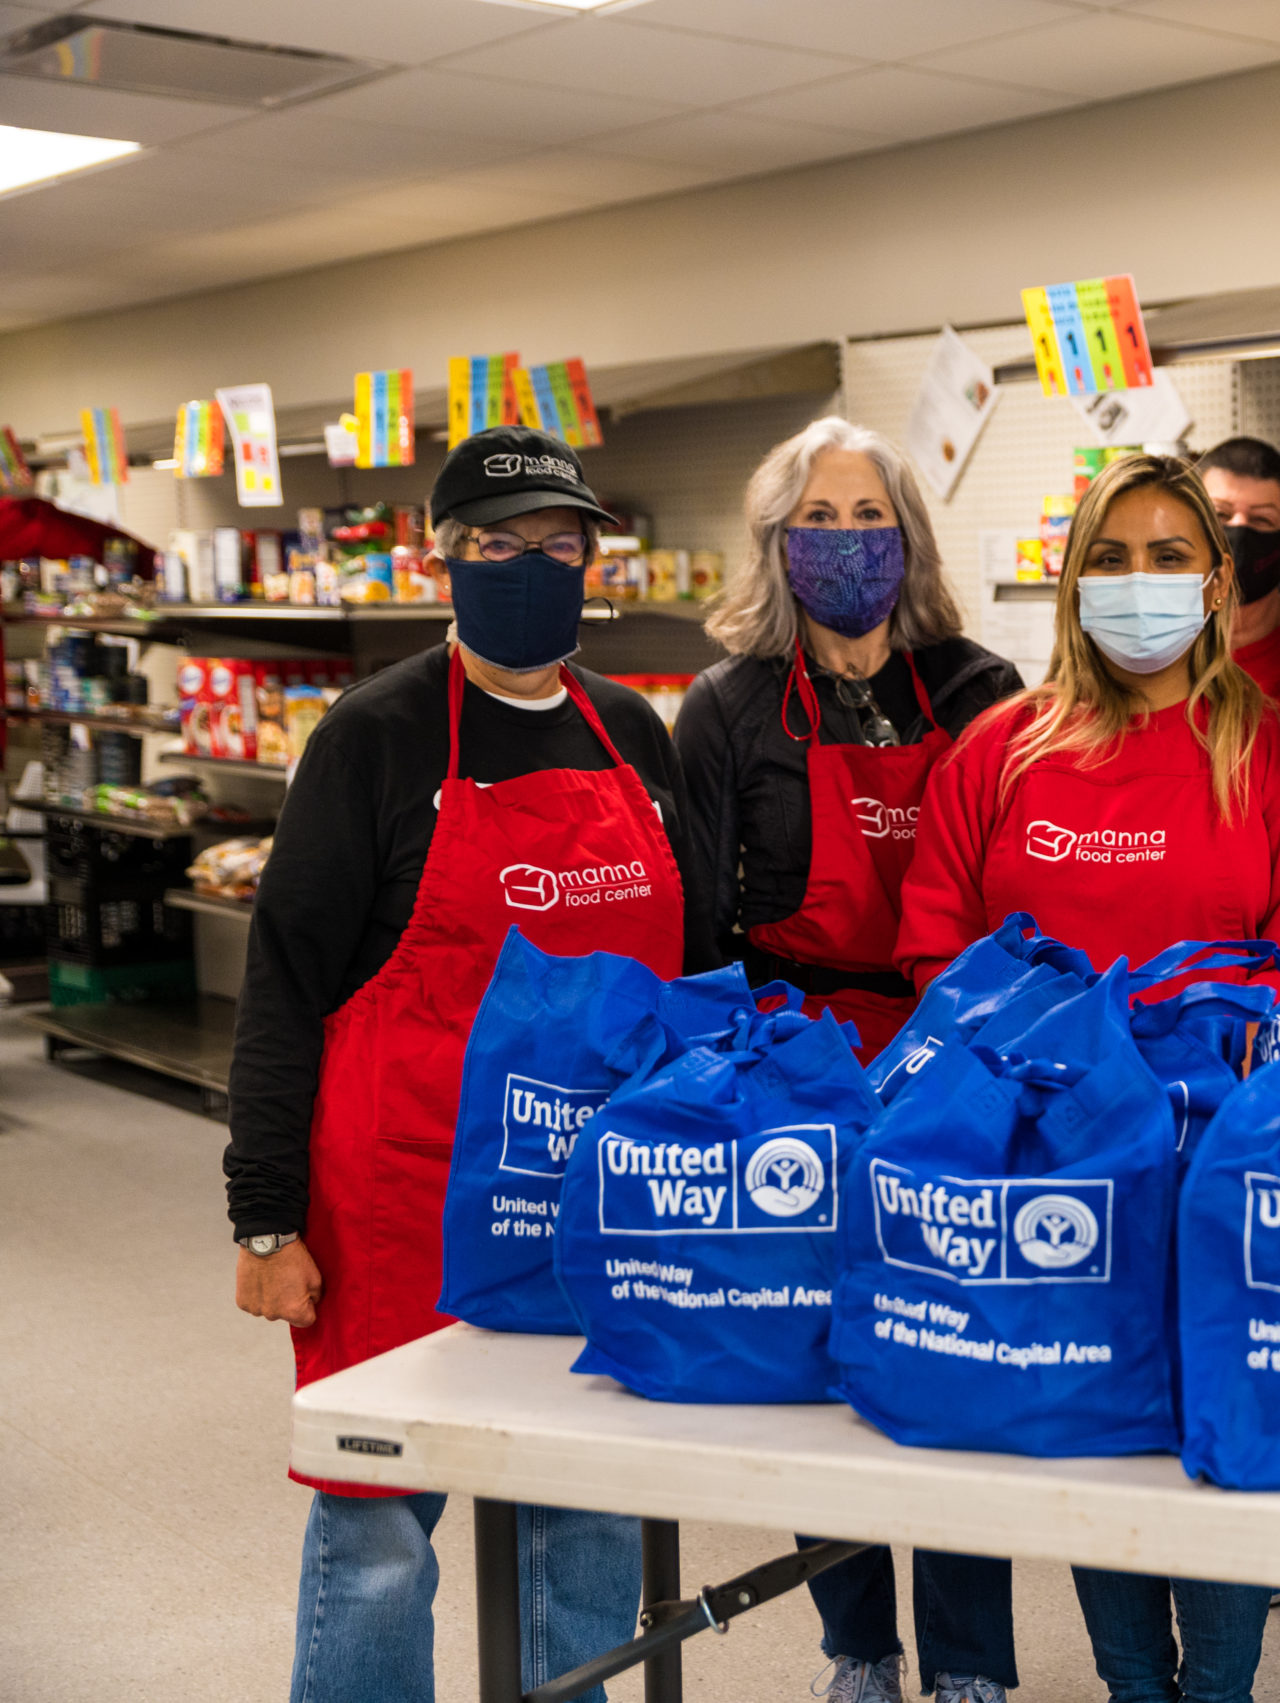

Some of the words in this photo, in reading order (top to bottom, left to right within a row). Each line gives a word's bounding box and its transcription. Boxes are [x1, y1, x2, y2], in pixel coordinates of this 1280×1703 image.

[1066, 329, 1079, 356] 1
[1095, 327, 1107, 352] 1
[1126, 323, 1138, 349] 1
[524, 455, 577, 475] manna
[1077, 829, 1166, 847] manna
[1075, 847, 1112, 864] food
[1115, 850, 1166, 864] center
[558, 860, 647, 888] manna
[565, 888, 601, 907] food
[604, 883, 653, 902] center
[607, 1140, 728, 1177] United
[492, 1195, 548, 1216] United
[647, 1178, 728, 1226] Way
[876, 1174, 997, 1229] United
[491, 1218, 512, 1237] of
[513, 1218, 542, 1237] the
[921, 1222, 997, 1277] Way
[605, 1258, 660, 1279] United
[659, 1263, 694, 1288] Way
[611, 1279, 630, 1300] of
[632, 1279, 660, 1301] the
[727, 1286, 790, 1310] Capital
[874, 1292, 928, 1322] United
[928, 1302, 971, 1334] Way
[874, 1318, 894, 1341] of
[893, 1320, 919, 1348] the
[919, 1327, 995, 1362] National
[995, 1341, 1061, 1371] Capital
[1063, 1341, 1112, 1365] Area
[1246, 1346, 1270, 1371] of
